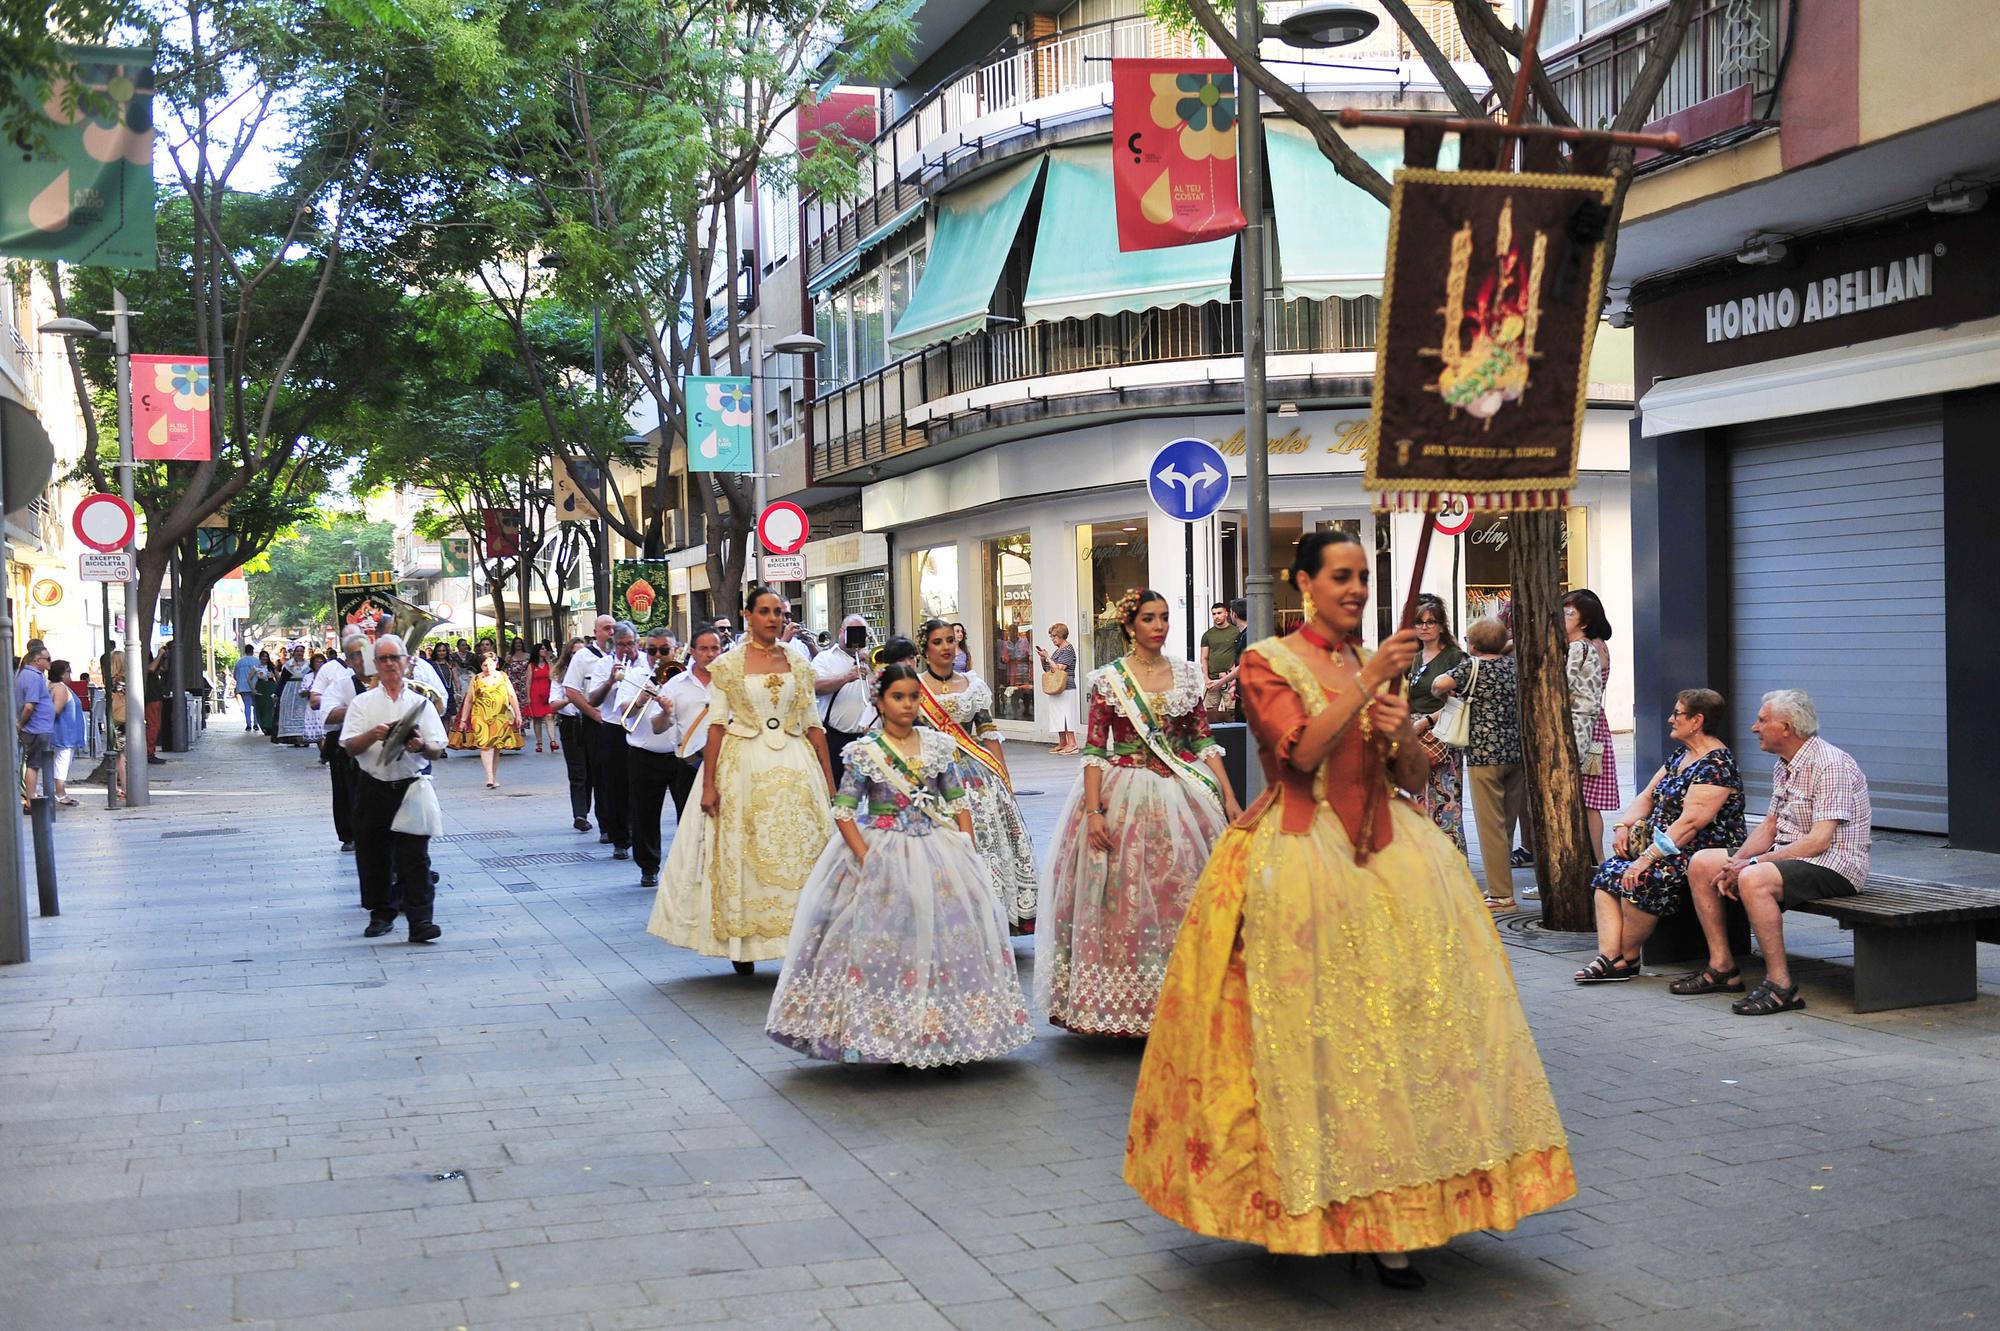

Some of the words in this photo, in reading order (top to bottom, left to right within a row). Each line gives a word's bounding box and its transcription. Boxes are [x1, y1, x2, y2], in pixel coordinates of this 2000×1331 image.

[1186, 184, 1201, 192] TEU
[1175, 193, 1205, 201] COSTAT
[1706, 288, 1799, 343] HORNO
[1803, 254, 1932, 323] ABELLAN
[1440, 500, 1464, 517] 20
